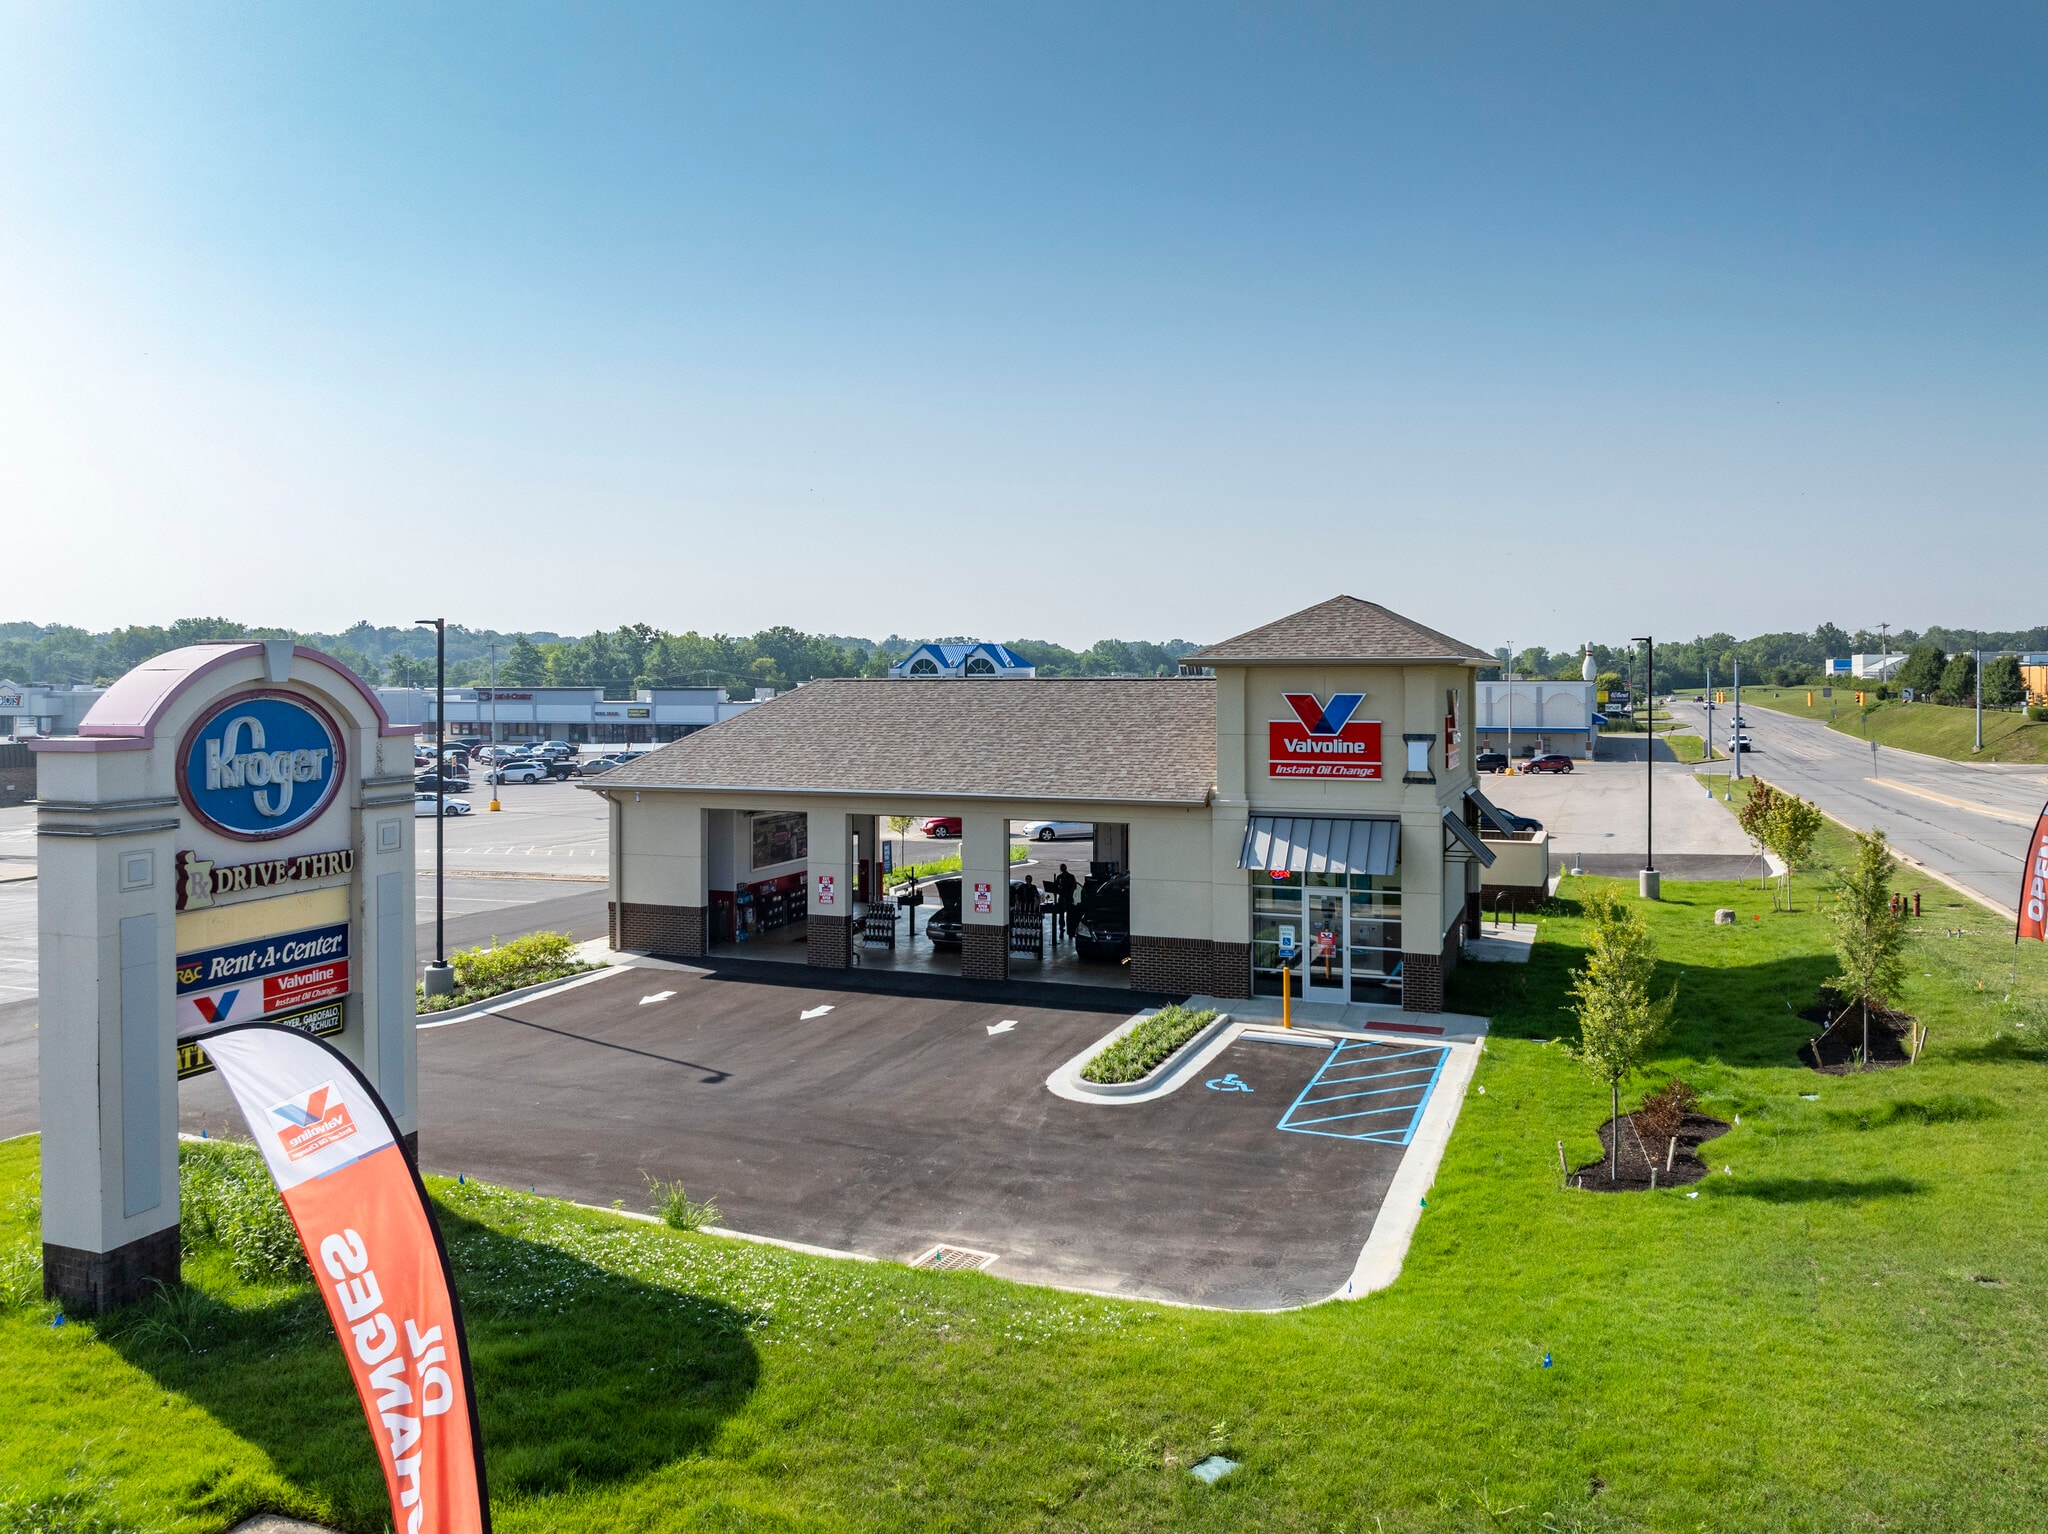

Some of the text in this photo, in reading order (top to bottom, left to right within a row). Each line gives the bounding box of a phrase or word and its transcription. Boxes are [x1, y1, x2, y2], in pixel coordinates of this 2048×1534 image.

[1284, 738, 1366, 753] Valvoline
[206, 716, 329, 817] Kroger
[1276, 765, 1375, 777] Instant Oil Change
[216, 850, 355, 894] DRIVE-THRU
[277, 968, 334, 990] Valvoline
[275, 986, 338, 1008] Instant Oil Change
[303, 1007, 340, 1024] GAROFALO,
[311, 1016, 339, 1032] SCHULTZ
